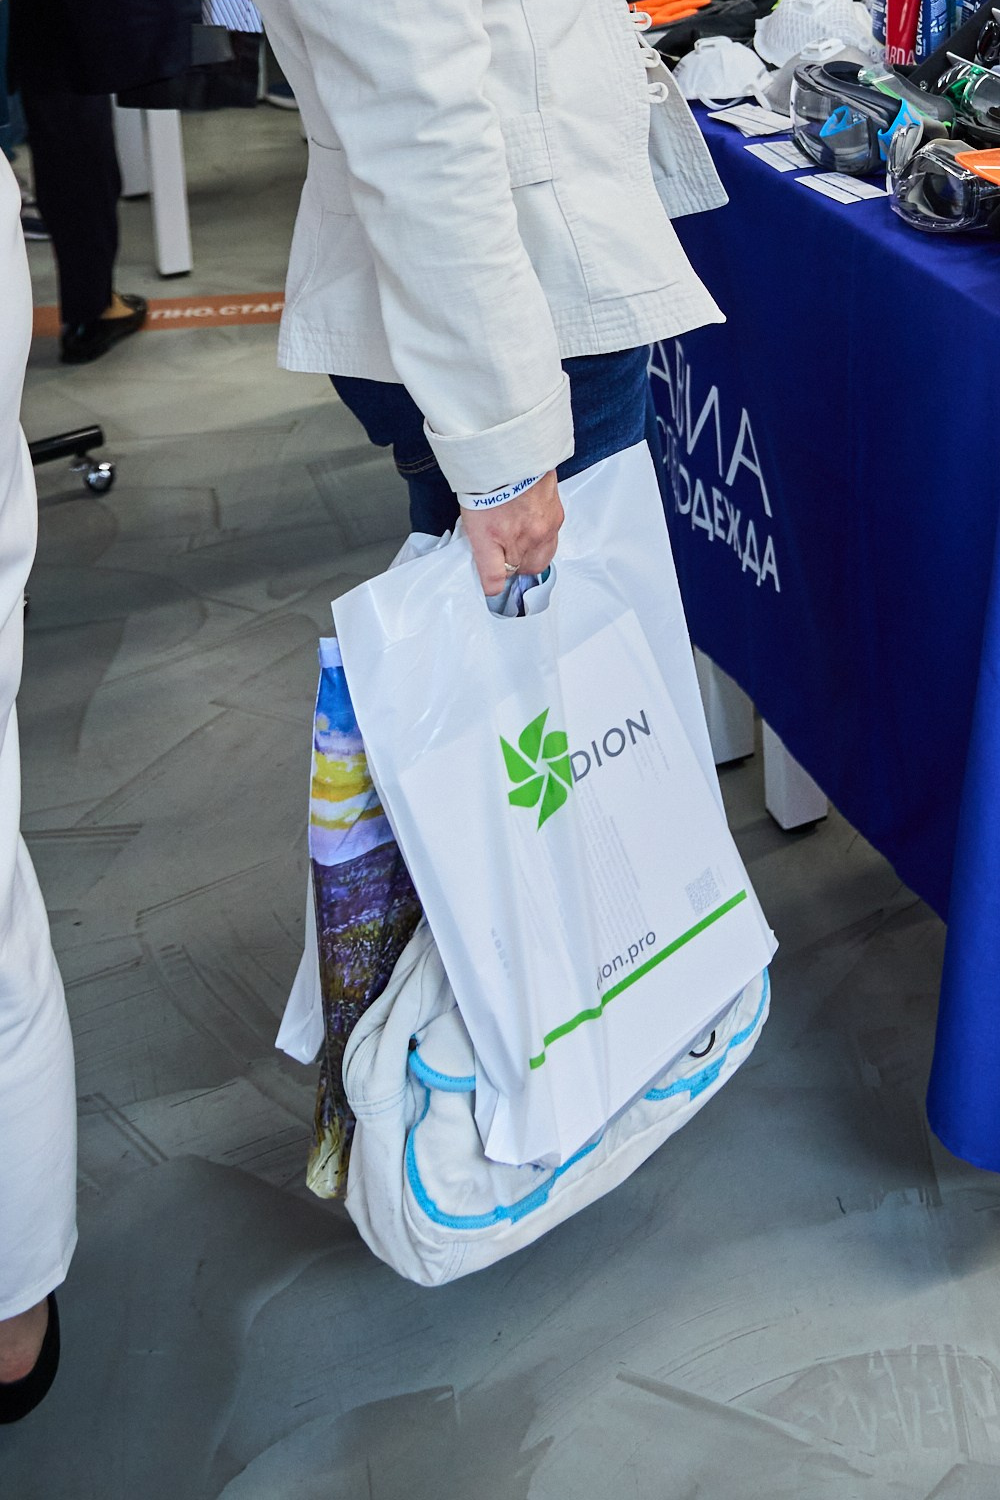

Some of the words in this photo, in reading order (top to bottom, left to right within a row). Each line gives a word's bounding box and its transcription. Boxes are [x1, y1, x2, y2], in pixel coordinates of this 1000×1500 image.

[885, 45, 916, 66] RDA
[473, 492, 511, 507] УЧИСЬ
[569, 709, 651, 783] DION
